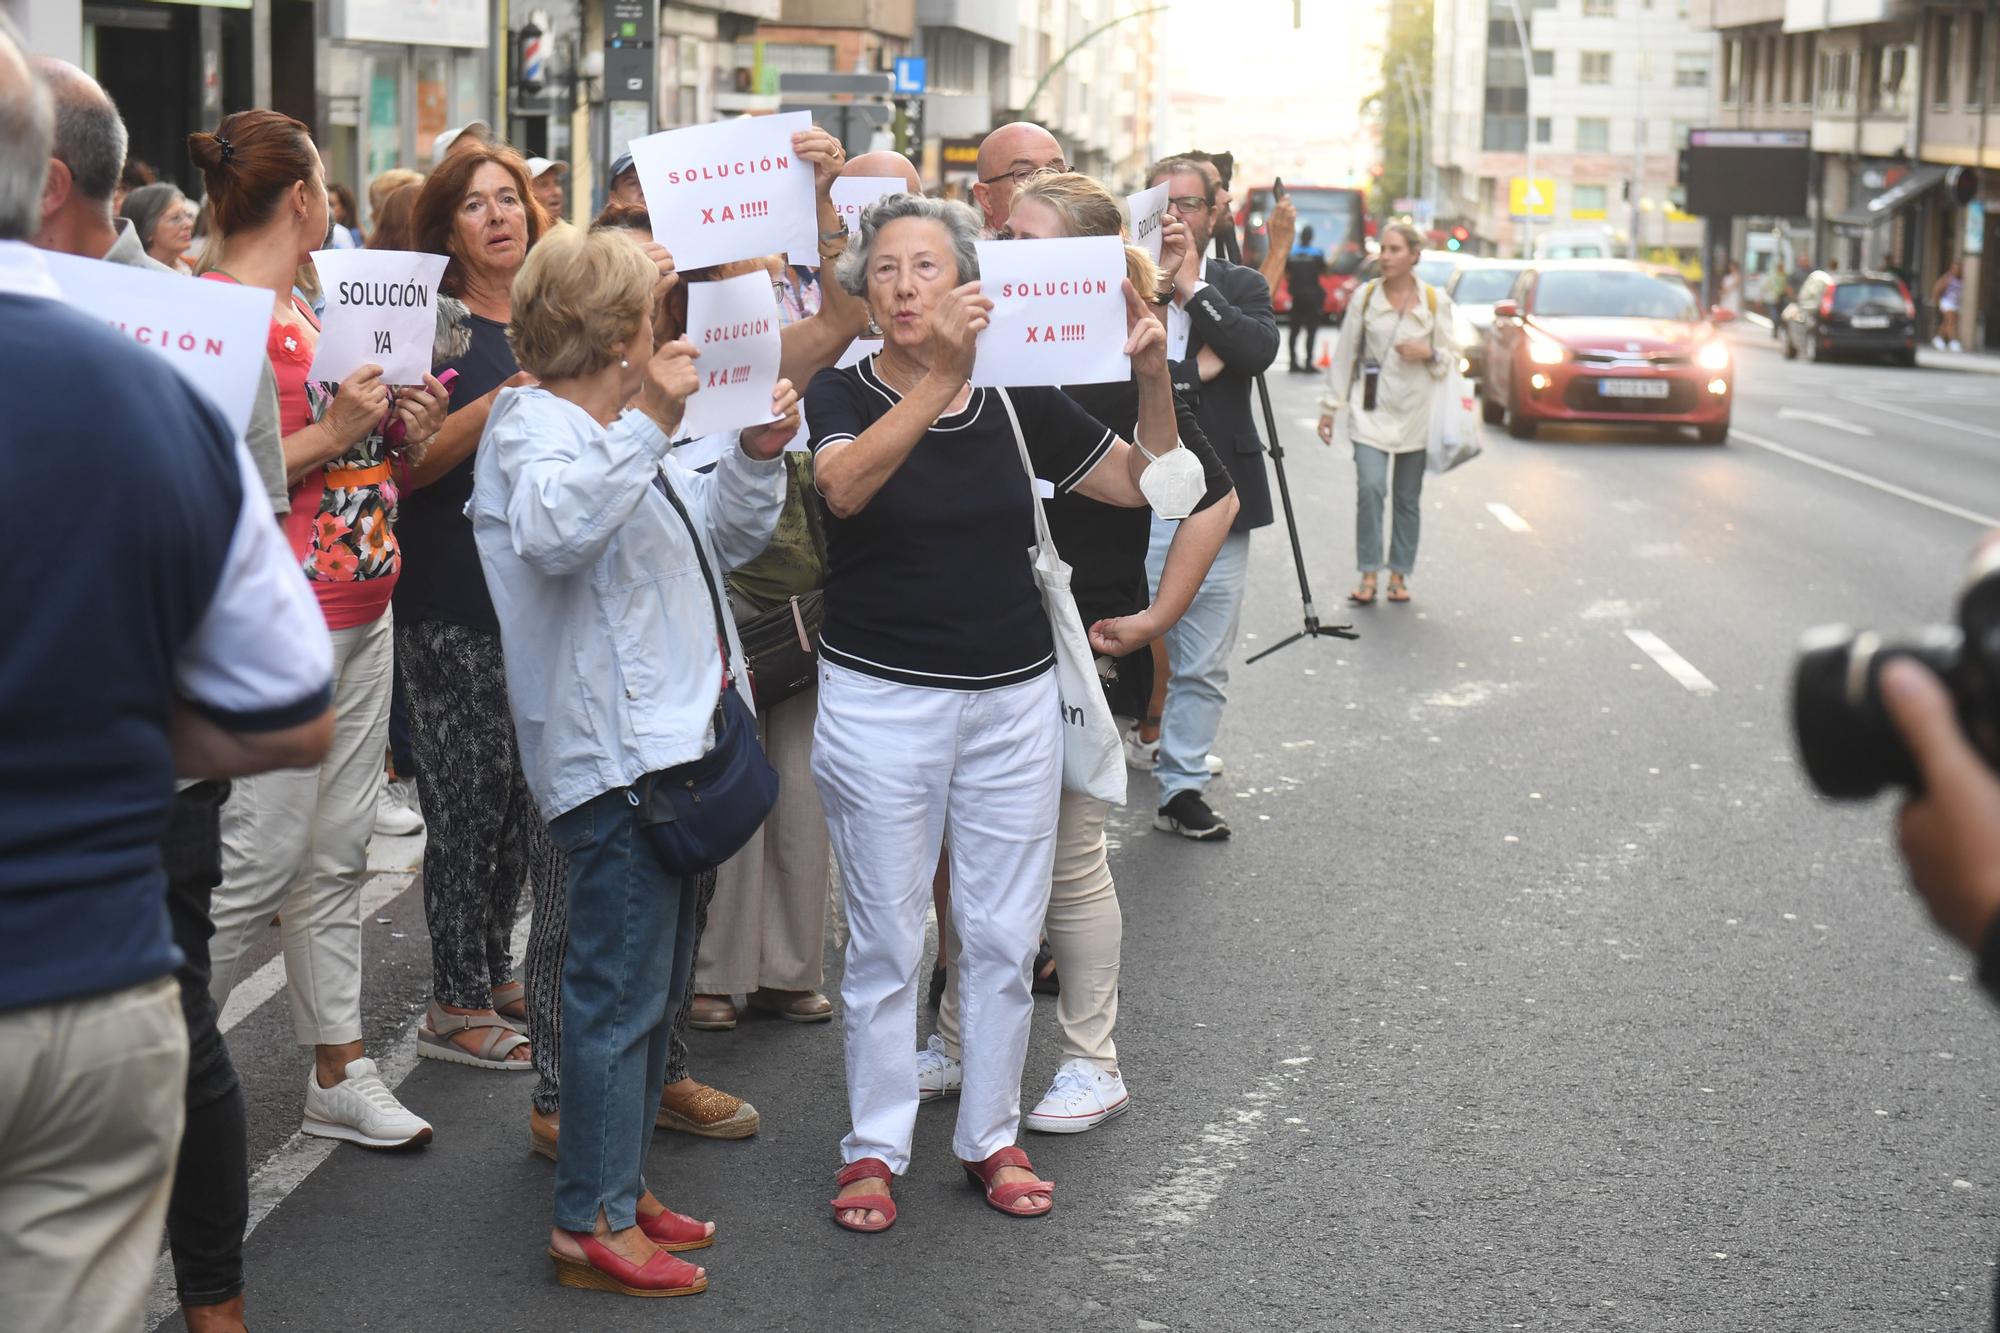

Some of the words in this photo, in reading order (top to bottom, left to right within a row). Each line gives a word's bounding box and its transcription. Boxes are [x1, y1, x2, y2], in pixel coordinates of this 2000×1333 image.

[668, 156, 788, 184] SOLUCIÓN
[339, 277, 428, 307] SOLUCIÓN
[1003, 277, 1106, 297] SOLUCIÓN
[374, 331, 392, 354] YA
[704, 316, 769, 344] SOLUCIÓN
